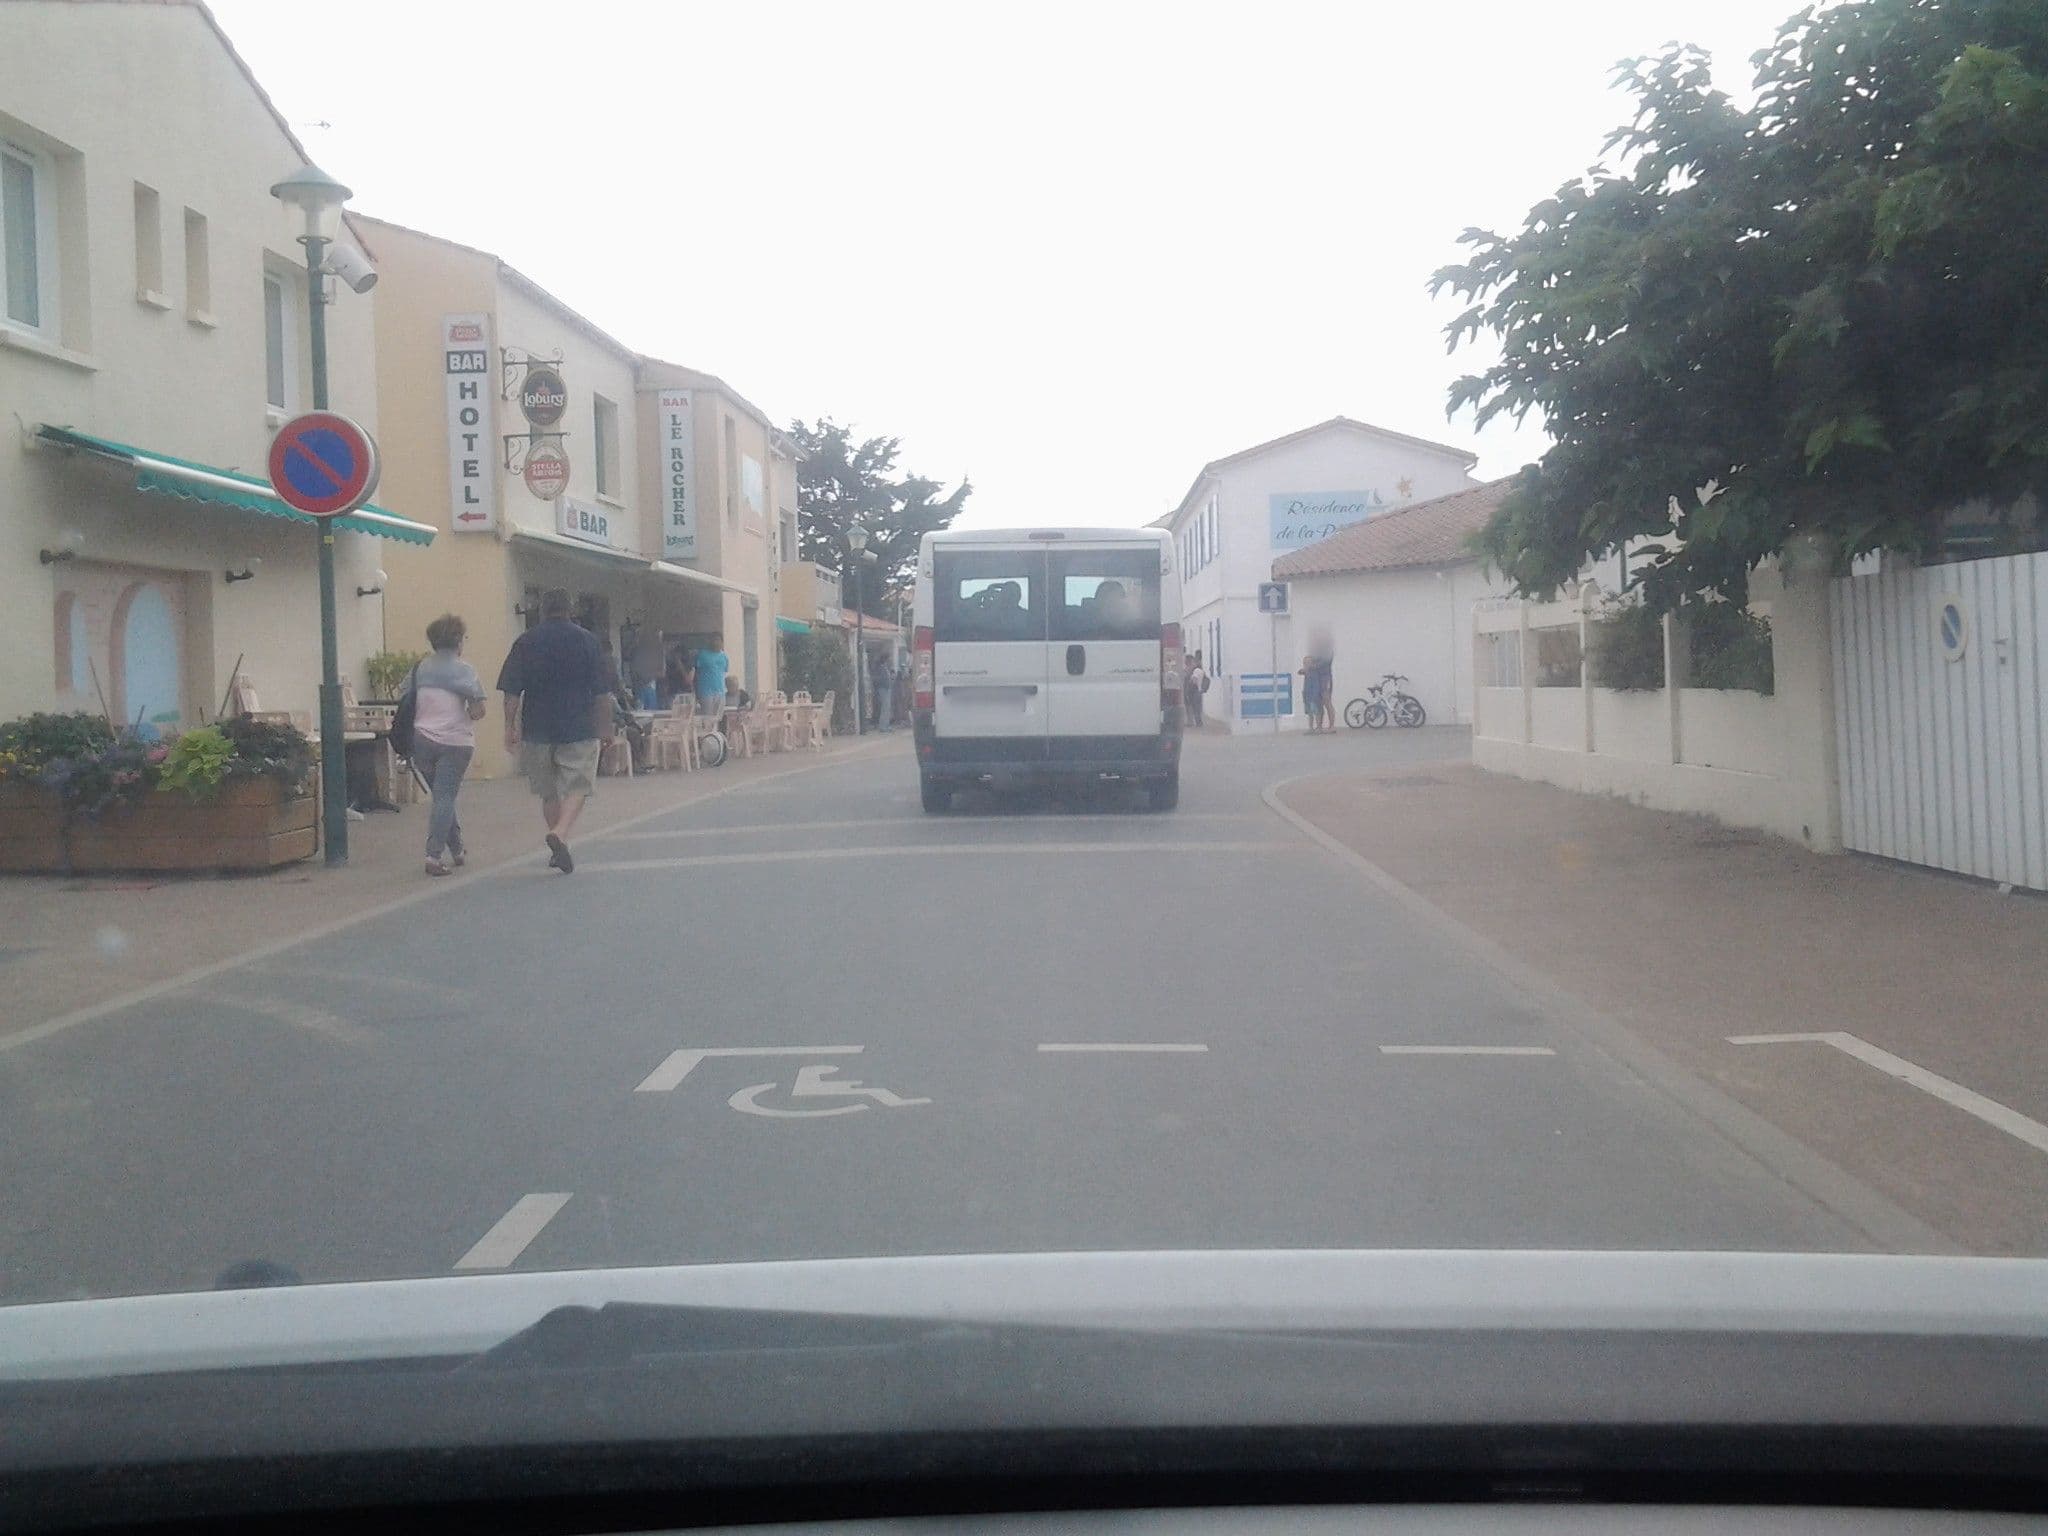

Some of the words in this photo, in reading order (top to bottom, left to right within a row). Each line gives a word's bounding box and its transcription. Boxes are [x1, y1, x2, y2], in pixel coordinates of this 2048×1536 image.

[449, 353, 485, 370] BAR
[662, 397, 689, 407] BAR
[671, 413, 683, 440] LE
[459, 381, 480, 504] HOTEL
[670, 447, 686, 526] ROCHER
[580, 510, 607, 537] BAR
